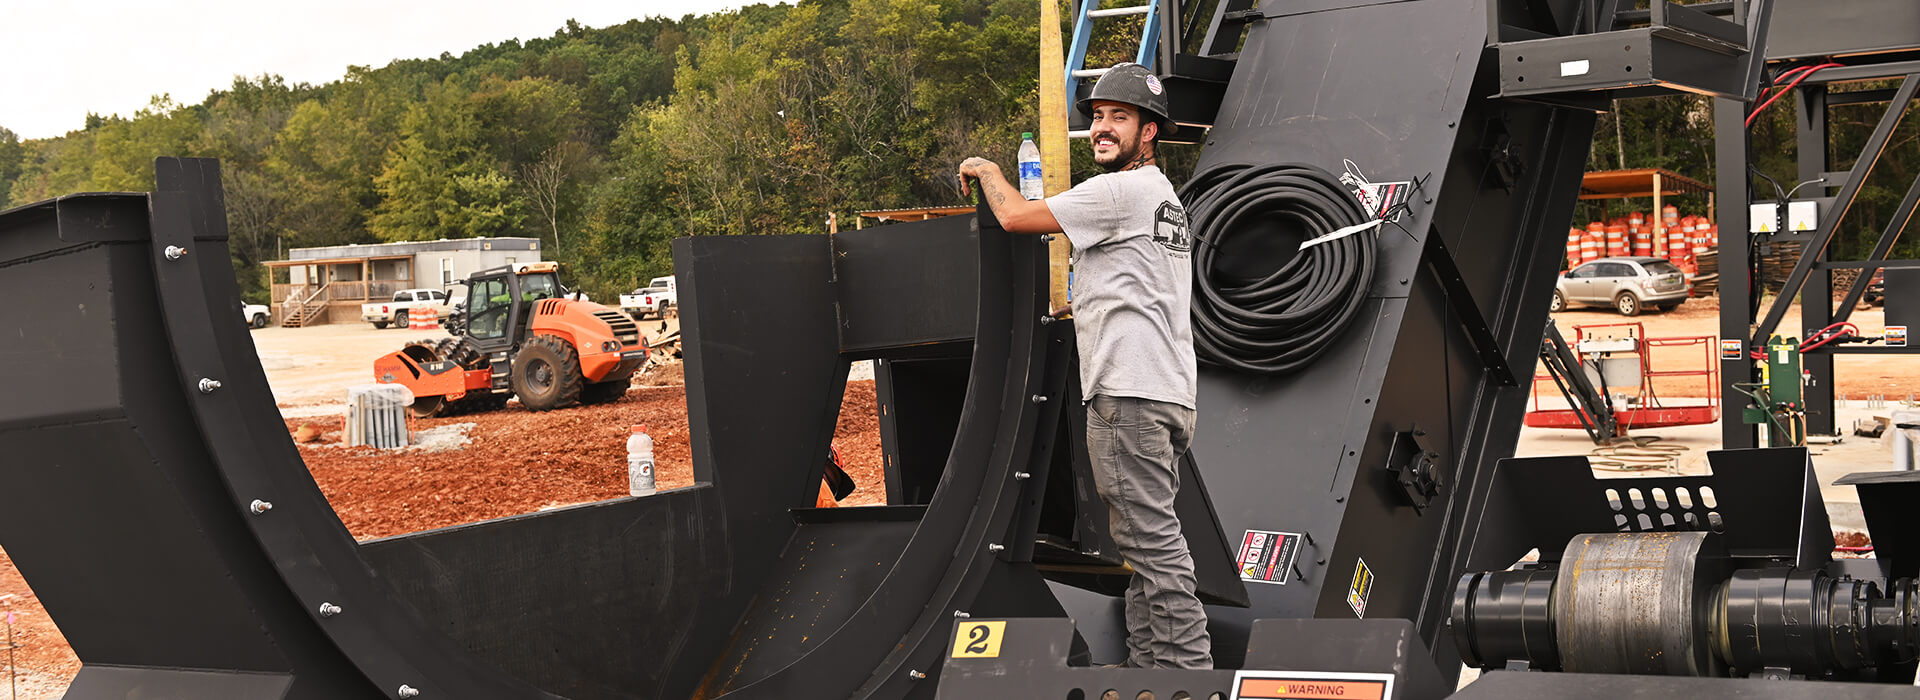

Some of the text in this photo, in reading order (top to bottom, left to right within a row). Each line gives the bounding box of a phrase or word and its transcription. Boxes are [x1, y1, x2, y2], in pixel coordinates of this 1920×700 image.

[1163, 206, 1184, 224] ASTEC
[965, 625, 990, 654] 2
[1288, 684, 1345, 696] WARNING
